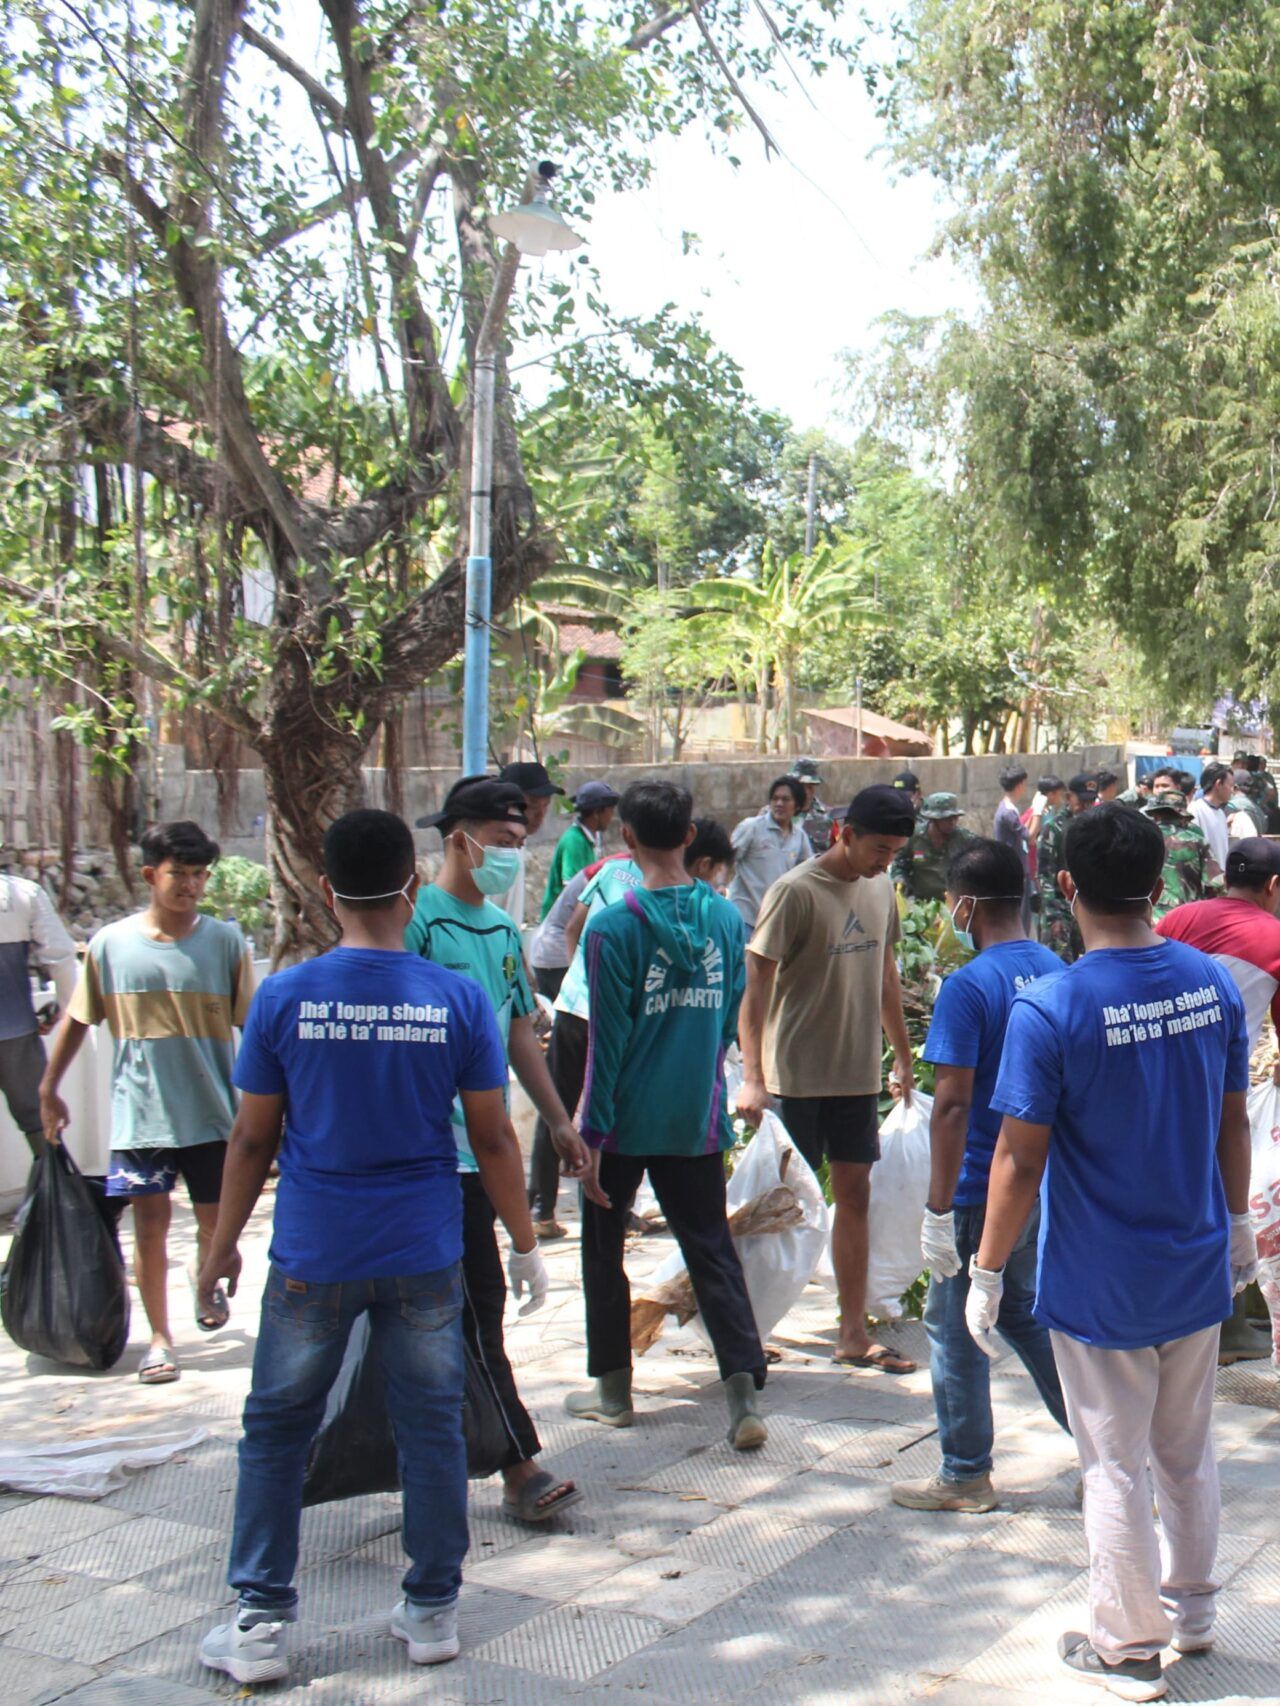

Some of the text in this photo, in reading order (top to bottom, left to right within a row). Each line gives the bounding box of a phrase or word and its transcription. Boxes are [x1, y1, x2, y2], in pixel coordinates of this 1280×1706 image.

[337, 1002, 389, 1022] loppa
[392, 1003, 448, 1024] sholat
[1133, 998, 1175, 1022] loppa
[1175, 984, 1219, 1012] sholat
[1167, 1004, 1223, 1036] malarat
[377, 1024, 447, 1044] malarat
